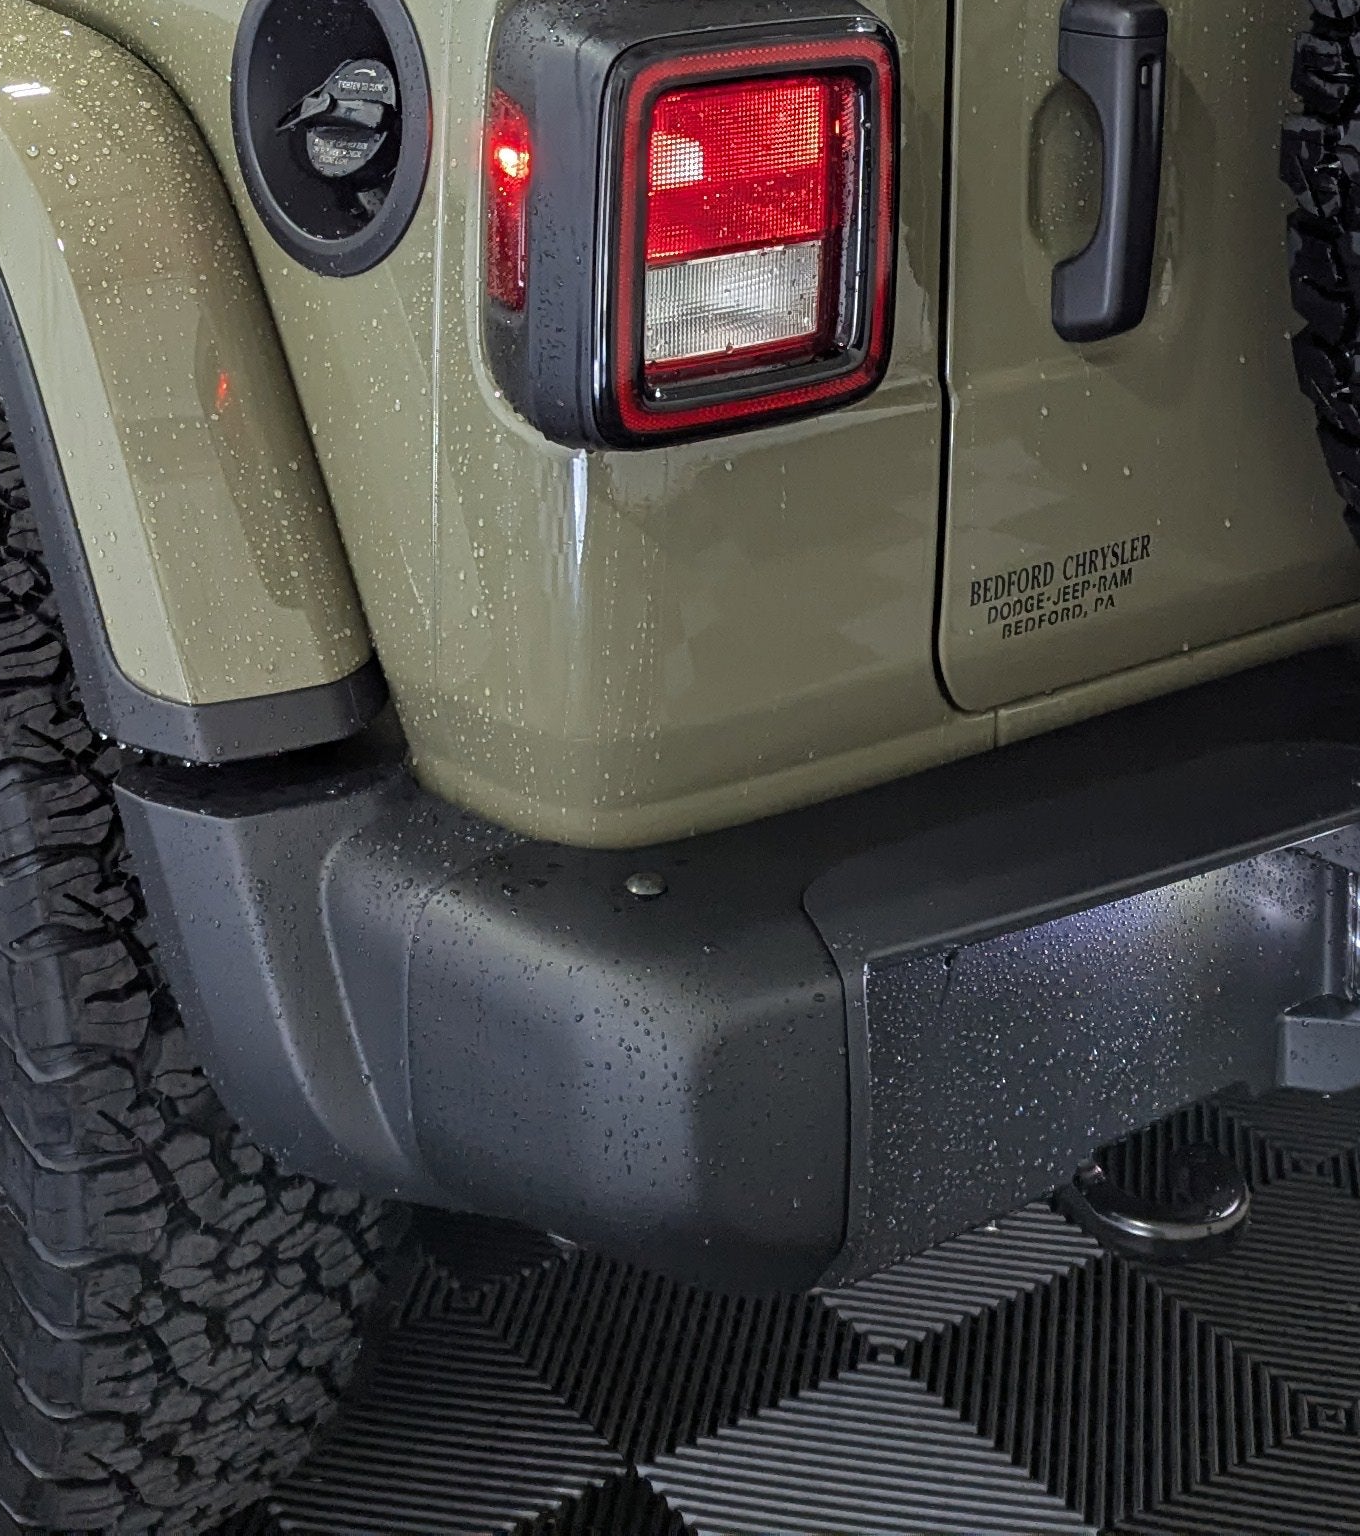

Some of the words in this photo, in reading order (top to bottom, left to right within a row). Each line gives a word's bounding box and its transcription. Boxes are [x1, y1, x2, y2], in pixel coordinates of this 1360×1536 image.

[970, 562, 1055, 607] BEDFORD
[1062, 534, 1151, 581] CHRYSLER
[1002, 604, 1087, 639] BEDFORD,
[1094, 595, 1115, 612] PA
